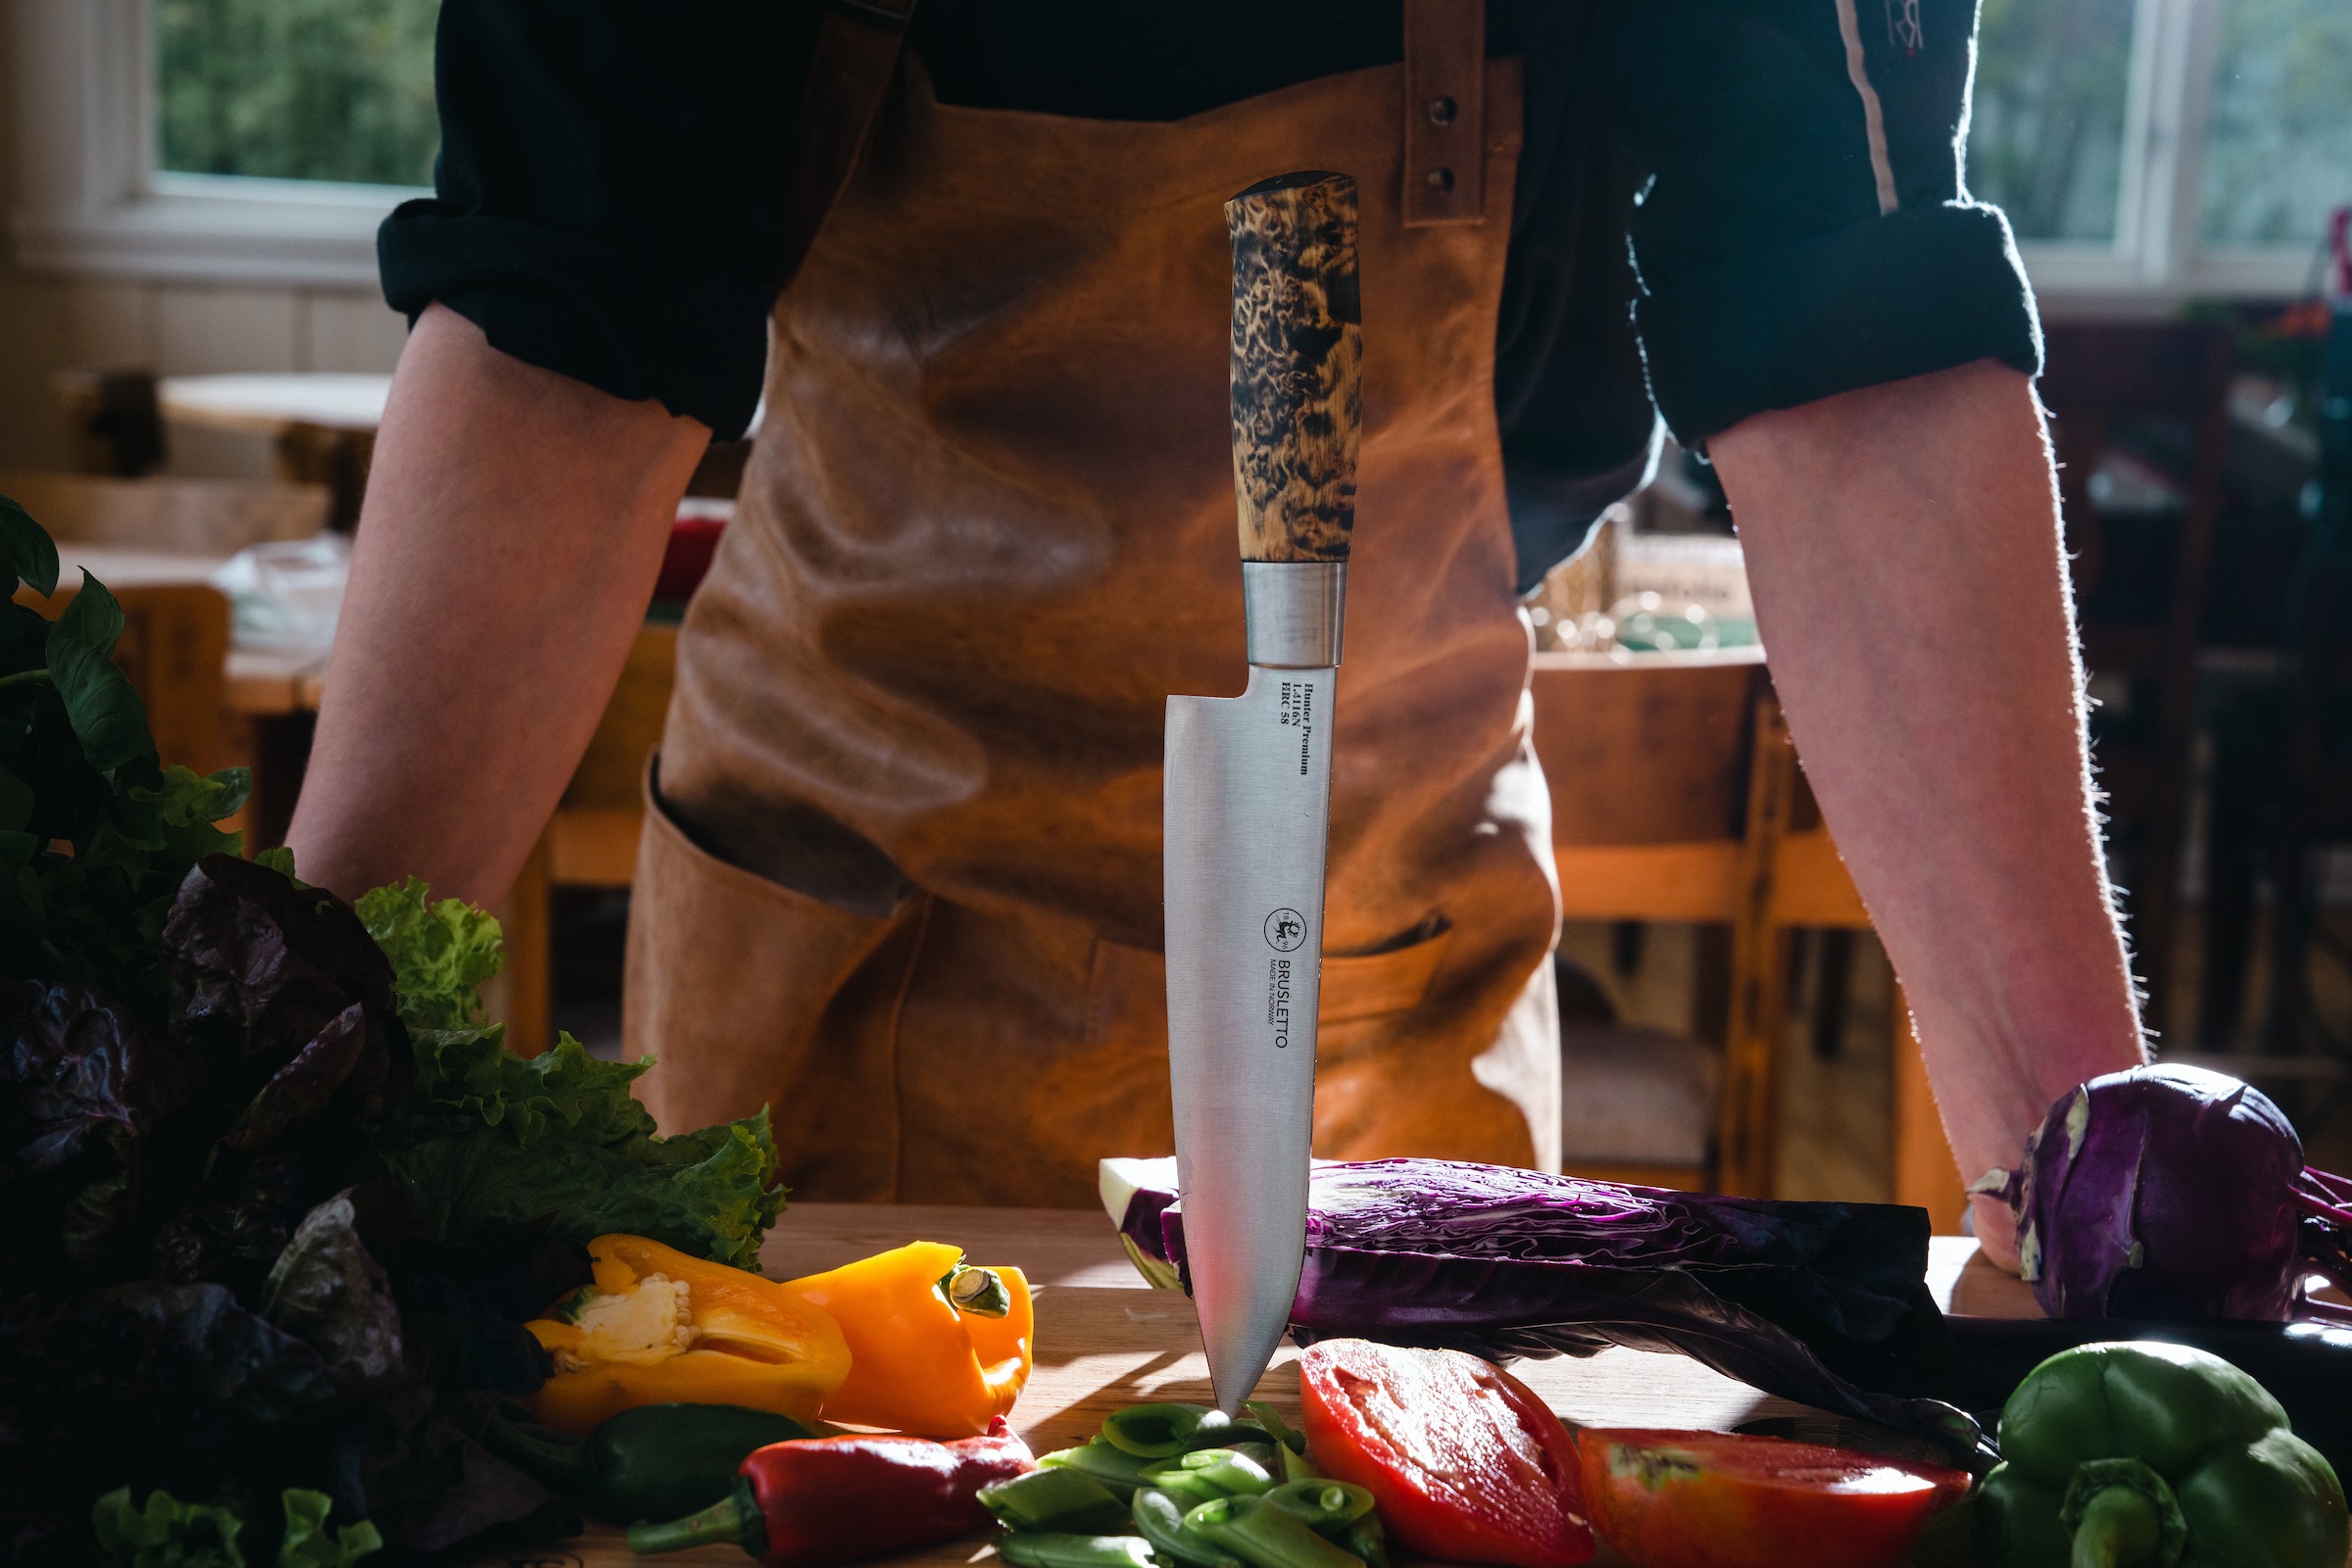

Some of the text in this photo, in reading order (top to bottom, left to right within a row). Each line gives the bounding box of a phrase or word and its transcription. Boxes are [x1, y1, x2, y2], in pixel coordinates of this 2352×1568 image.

[1280, 682, 1291, 725] HRC 58
[1292, 683, 1302, 727] 1.4116N
[1300, 683, 1313, 775] Hunter Premium
[1281, 911, 1290, 950] 18 96
[1268, 983, 1275, 992] IN
[1275, 959, 1291, 1049] BRUSLETTO
